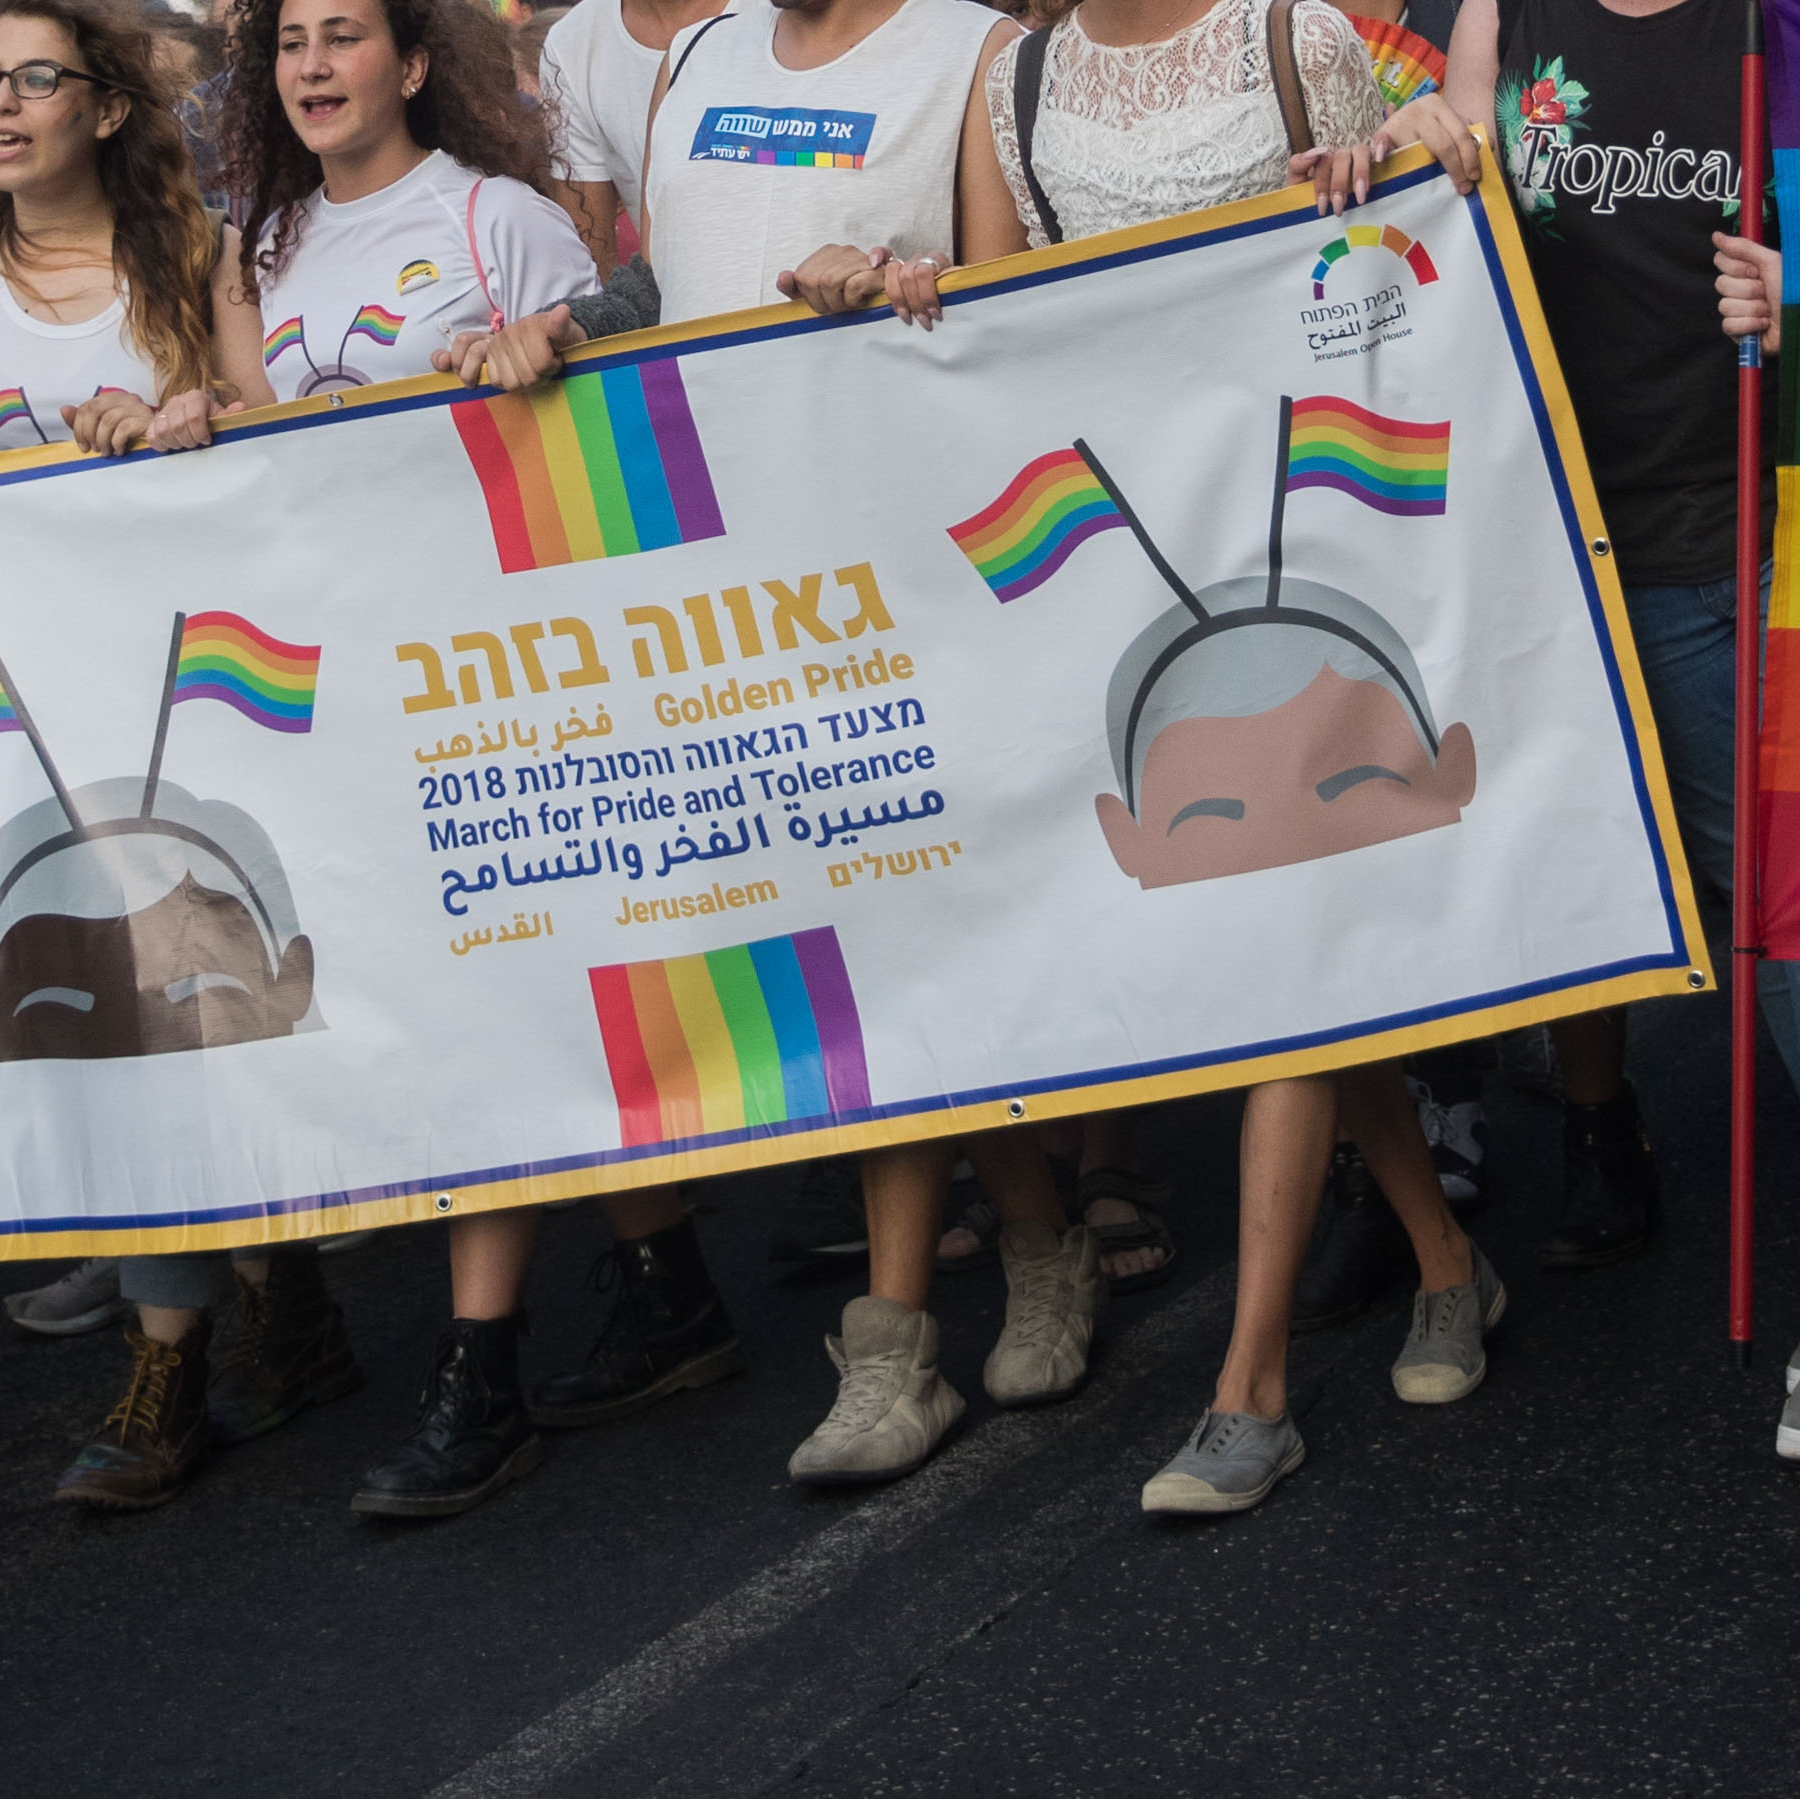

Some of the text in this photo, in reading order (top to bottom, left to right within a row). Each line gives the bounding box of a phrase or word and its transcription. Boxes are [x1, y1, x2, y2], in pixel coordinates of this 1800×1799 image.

[719, 116, 855, 138] אני ממש שווה
[1520, 123, 1741, 214] Tropica
[1300, 284, 1402, 325] הבית הפתוח
[1307, 302, 1407, 350] البيت المفتوح
[1313, 326, 1414, 363] Jerusalem Open House
[395, 561, 897, 715] גאווה בזהב
[654, 648, 915, 727] Golden Pride
[414, 703, 614, 773] فخر بالذهب
[418, 697, 926, 810] מצעד הגאווה והסובלנות 2018
[426, 745, 936, 852] March for Pride and Tolerance
[441, 789, 945, 916] مسيرة الفخر والتسامح
[826, 839, 963, 889] ירושלים
[615, 878, 779, 927] Jerusalem
[449, 911, 554, 956] القدس
